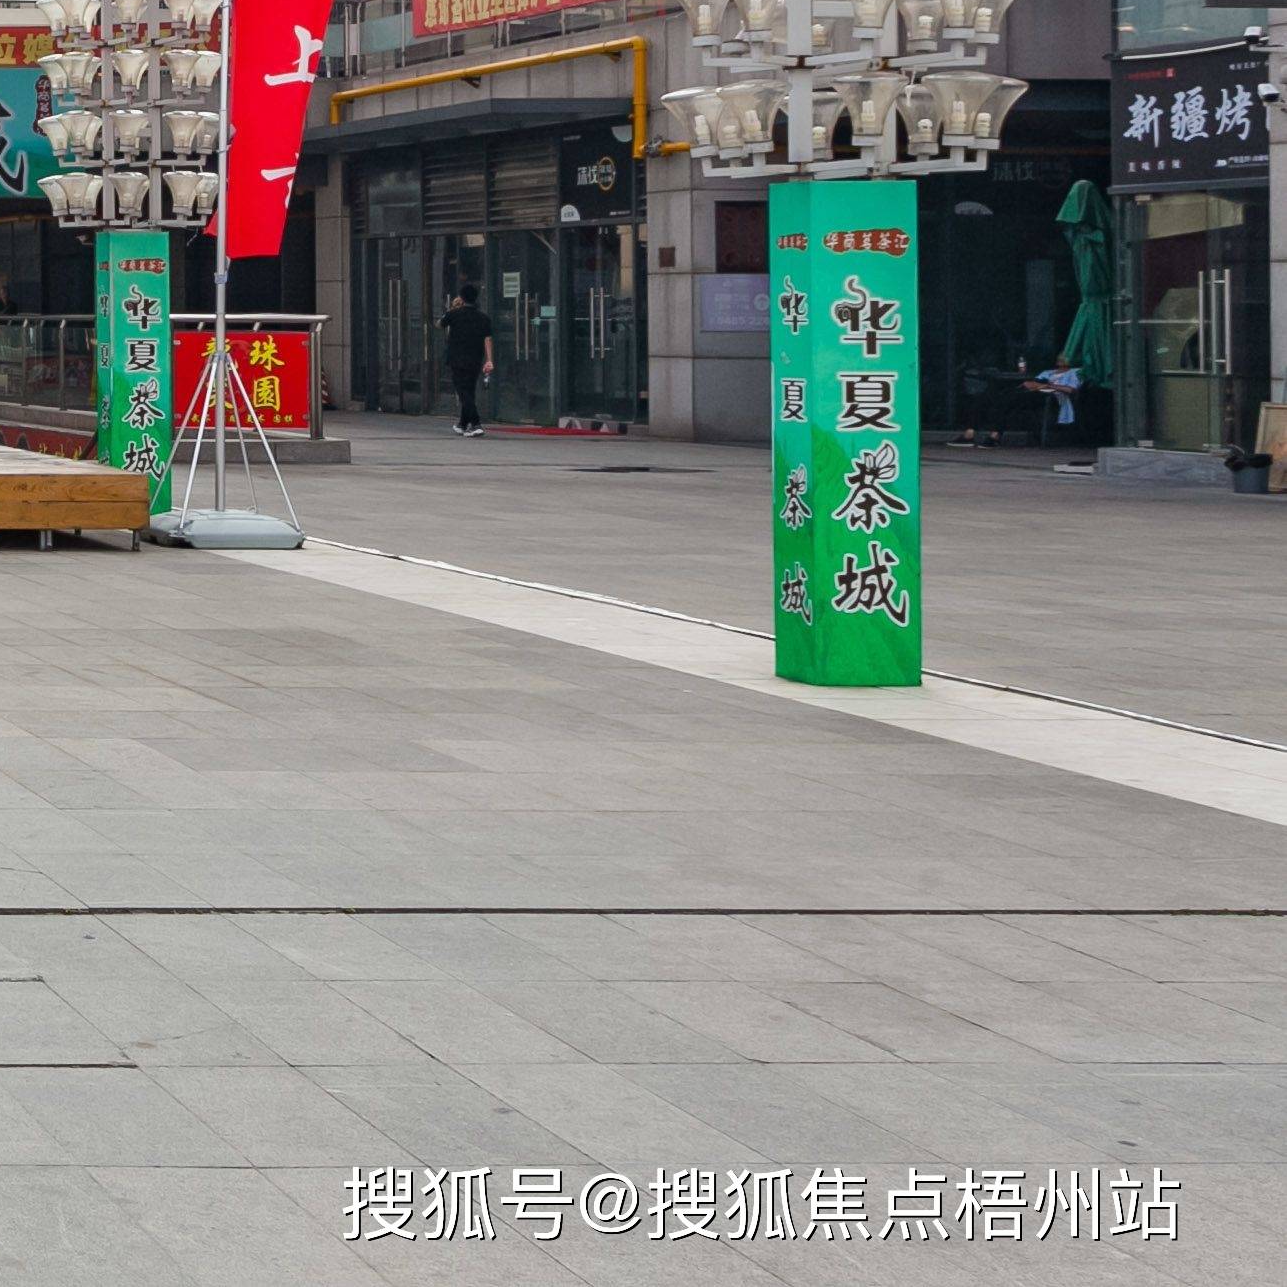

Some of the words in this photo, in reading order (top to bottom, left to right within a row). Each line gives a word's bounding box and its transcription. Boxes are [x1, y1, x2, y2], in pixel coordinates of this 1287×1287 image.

[1123, 84, 1269, 148] 新疆烤
[780, 275, 813, 626] 华夏茶城
[830, 275, 911, 627] 华夏茶城
